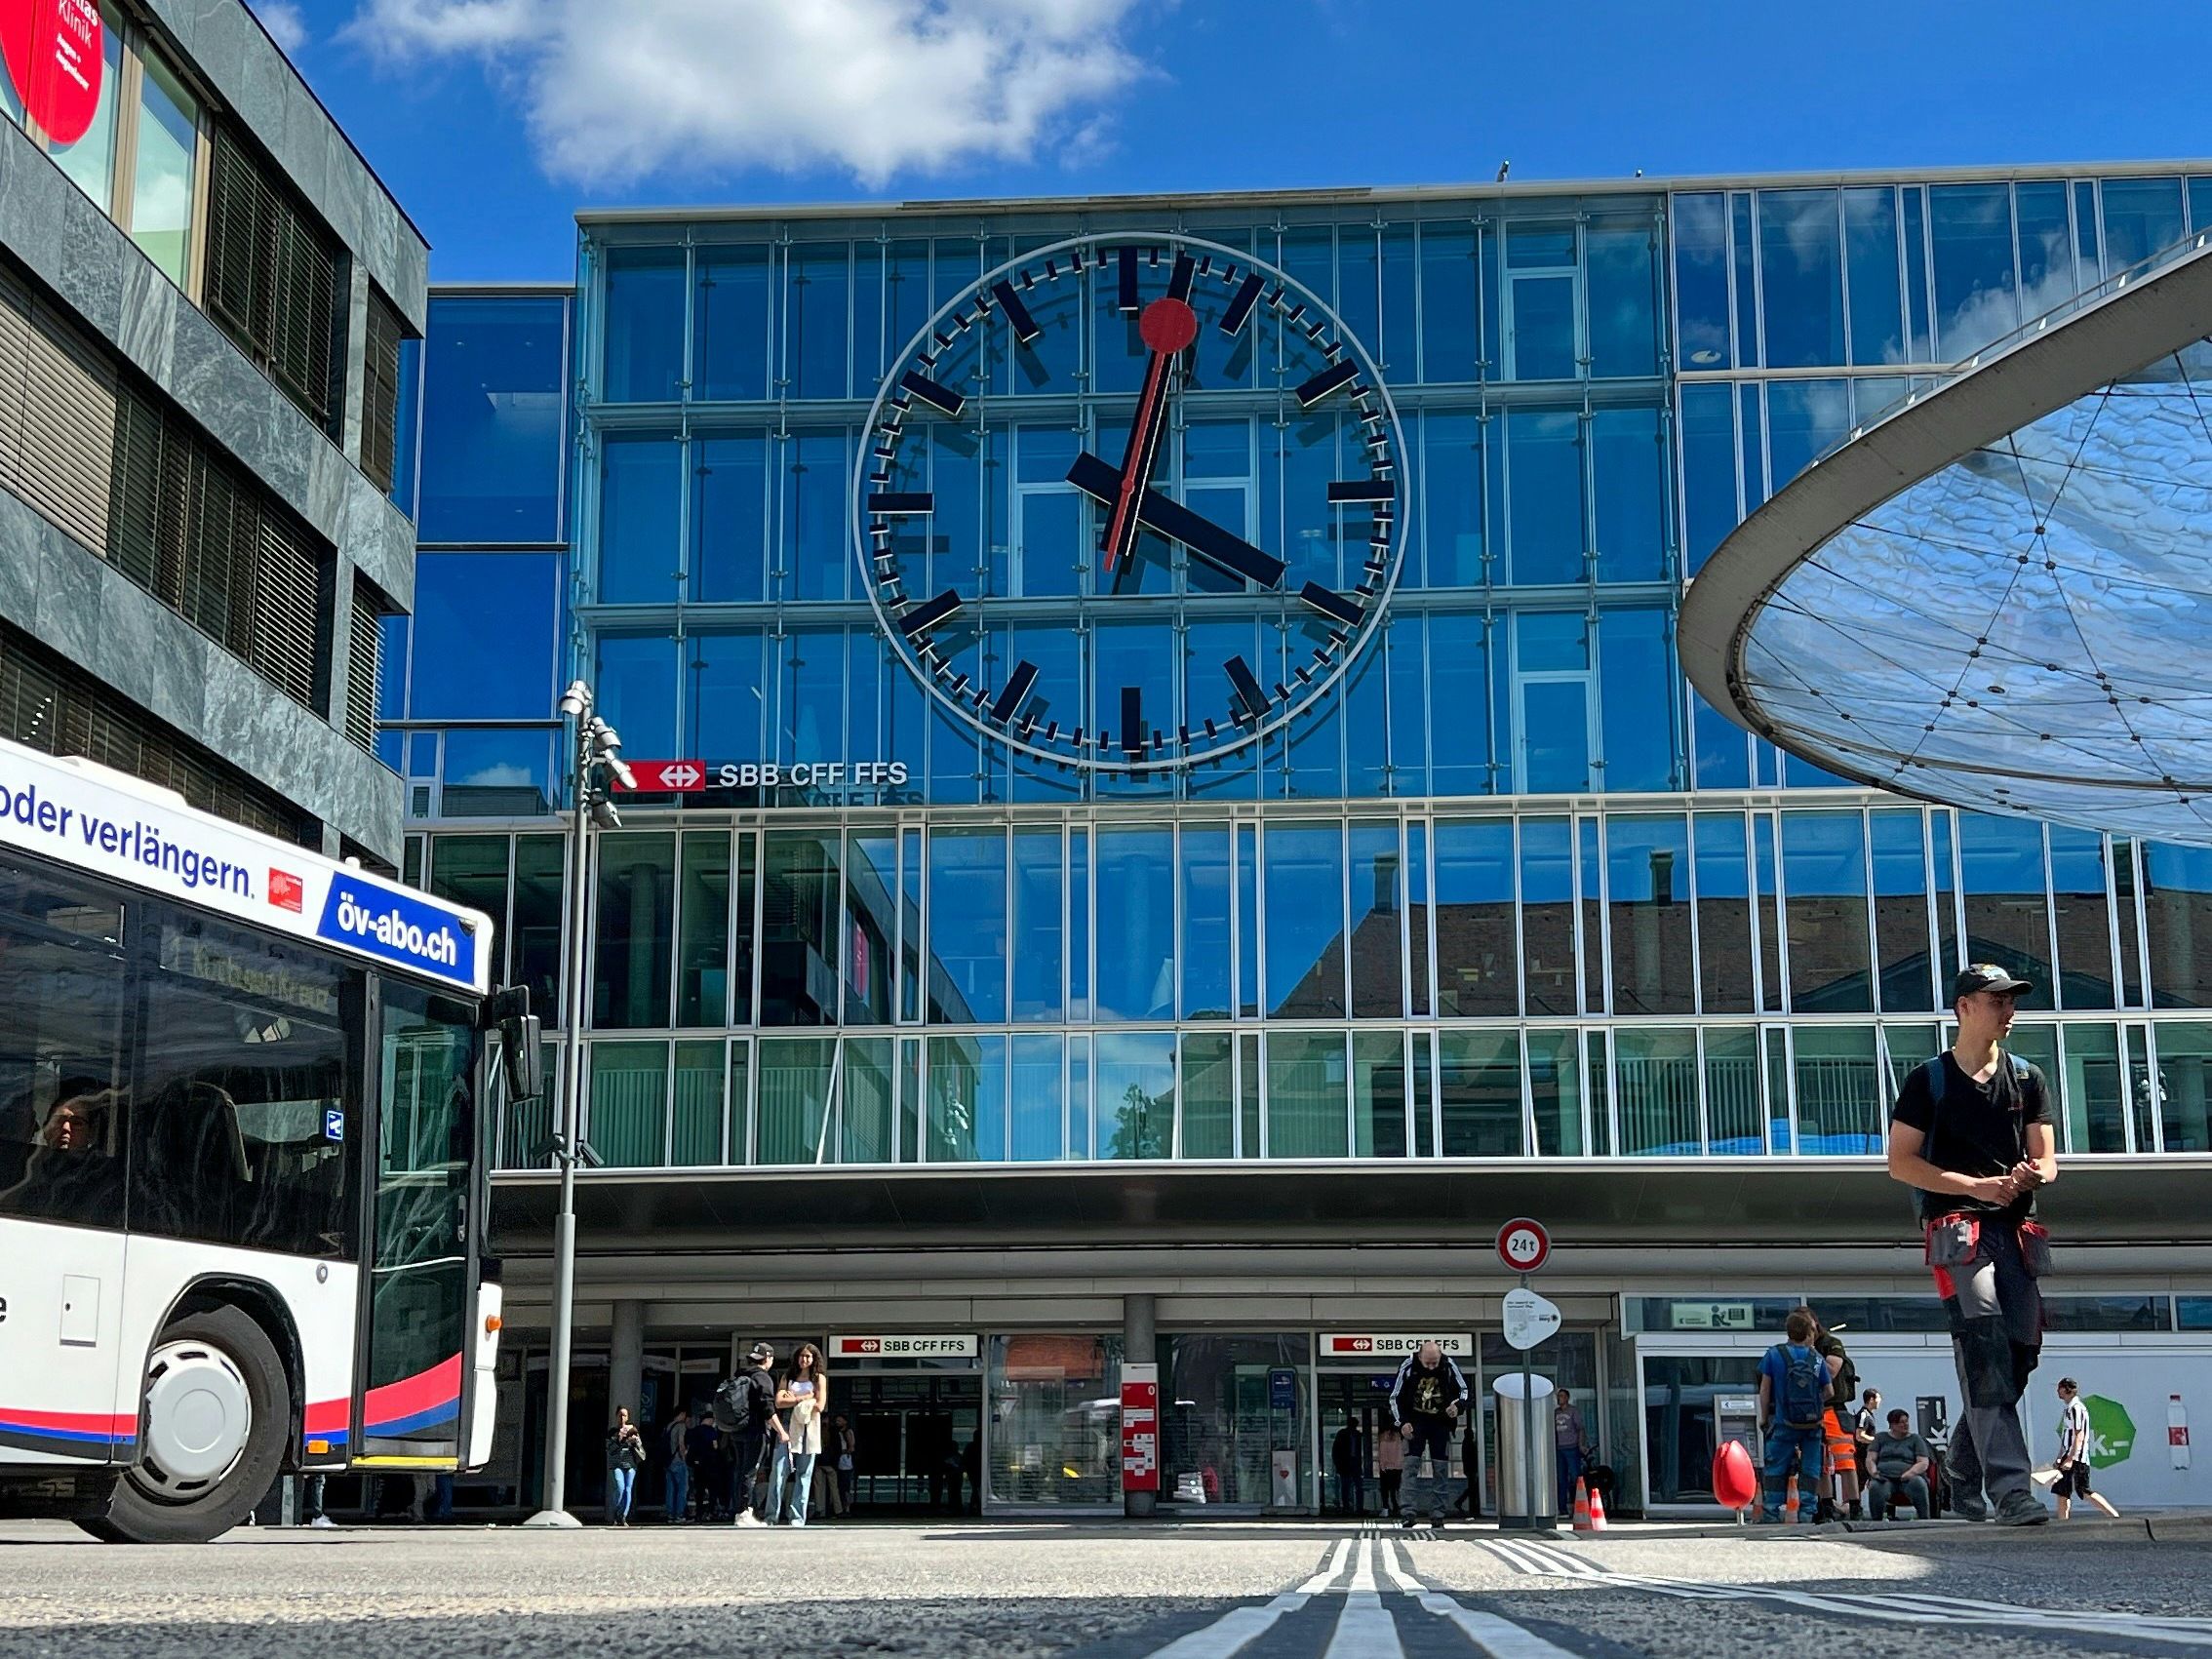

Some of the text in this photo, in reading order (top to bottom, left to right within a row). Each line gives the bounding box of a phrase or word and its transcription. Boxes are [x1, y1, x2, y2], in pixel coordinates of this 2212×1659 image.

[58, 0, 93, 51] Klinik
[720, 762, 908, 787] SBB CFF FFS
[0, 784, 256, 900] oder verlängern.
[337, 890, 457, 967] öv-abo.ch
[884, 1340, 965, 1352] SBB CFF FFS
[1376, 1339, 1403, 1351] SBB
